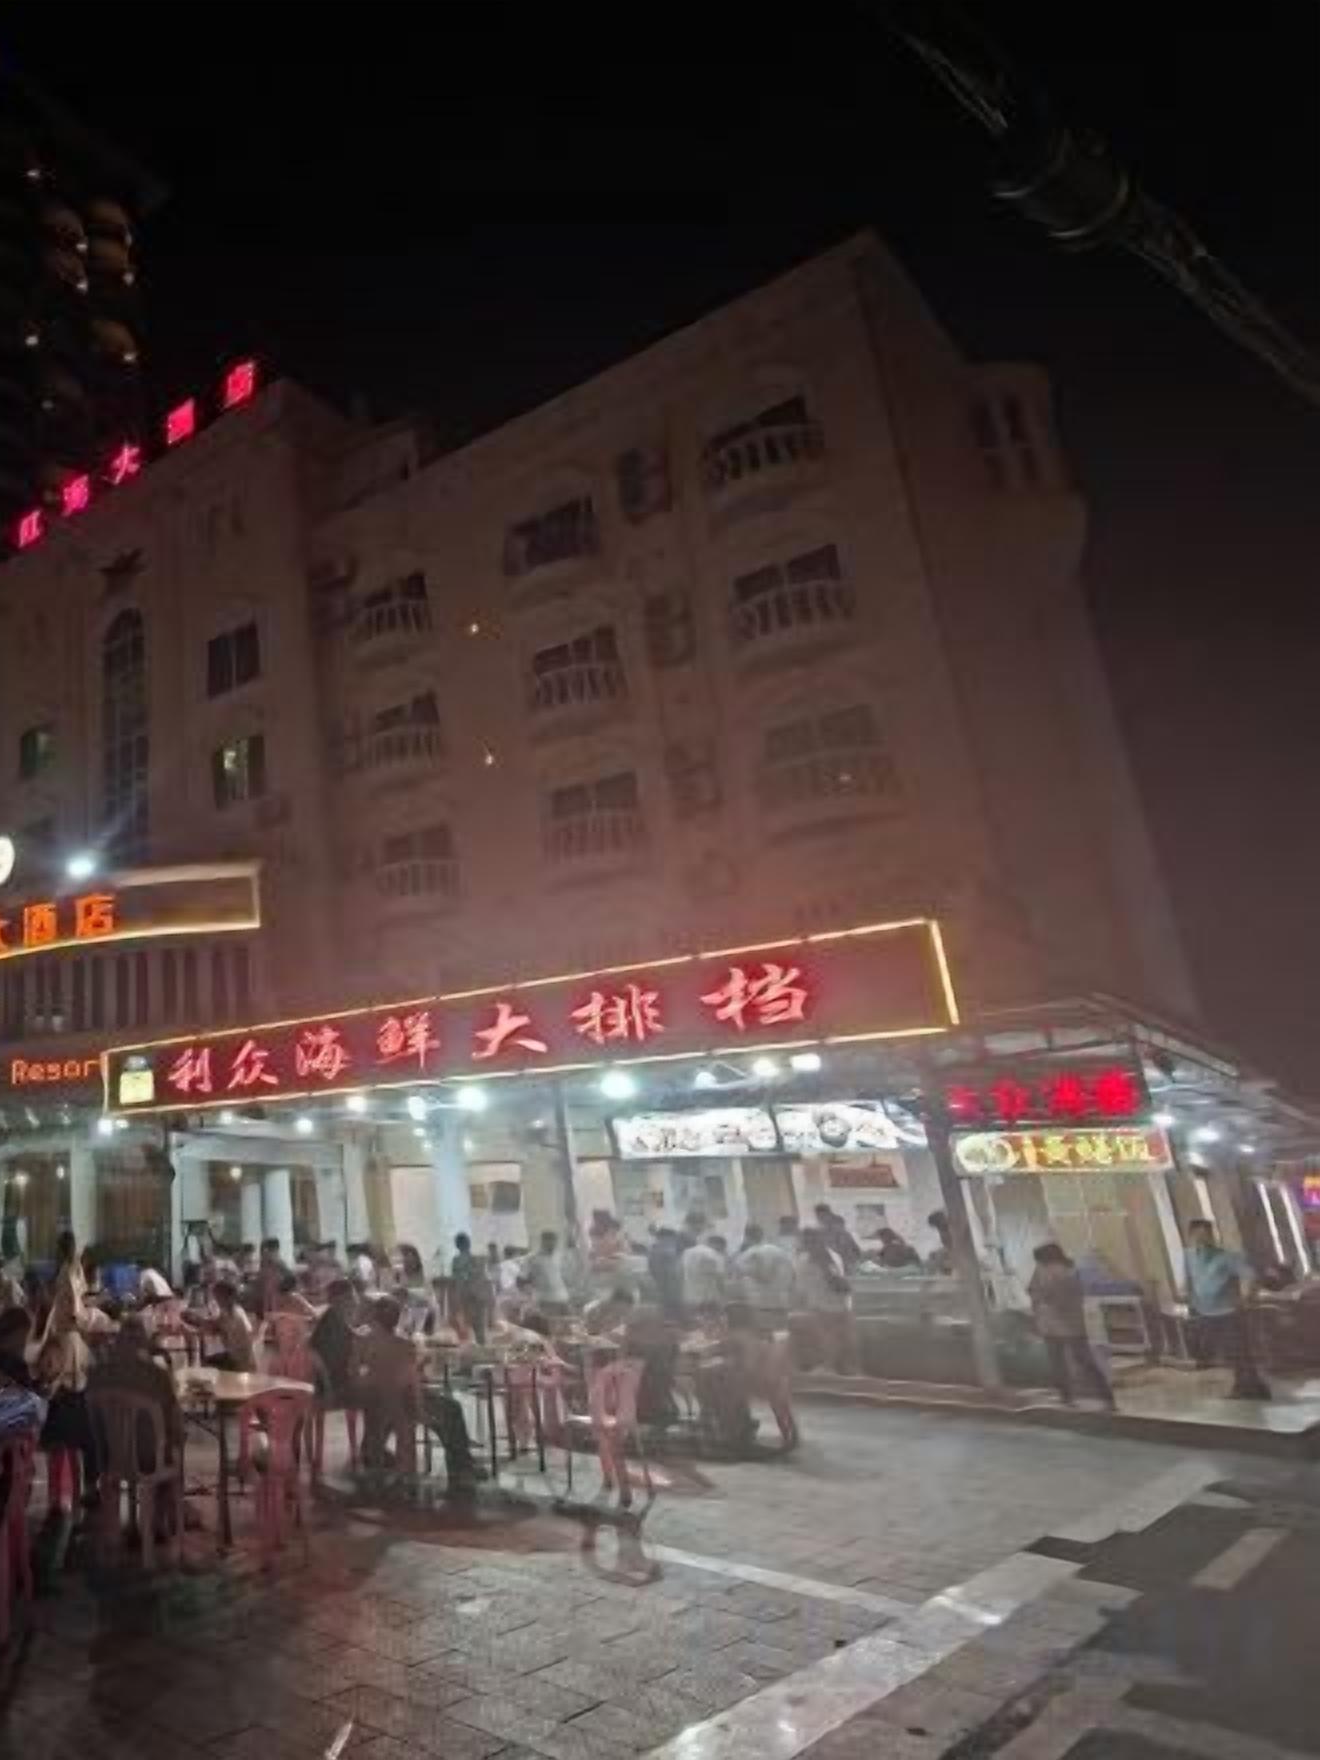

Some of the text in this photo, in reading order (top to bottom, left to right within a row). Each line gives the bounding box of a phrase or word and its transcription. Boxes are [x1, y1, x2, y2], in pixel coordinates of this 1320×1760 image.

[168, 964, 808, 1093] 利众海鲜大排档
